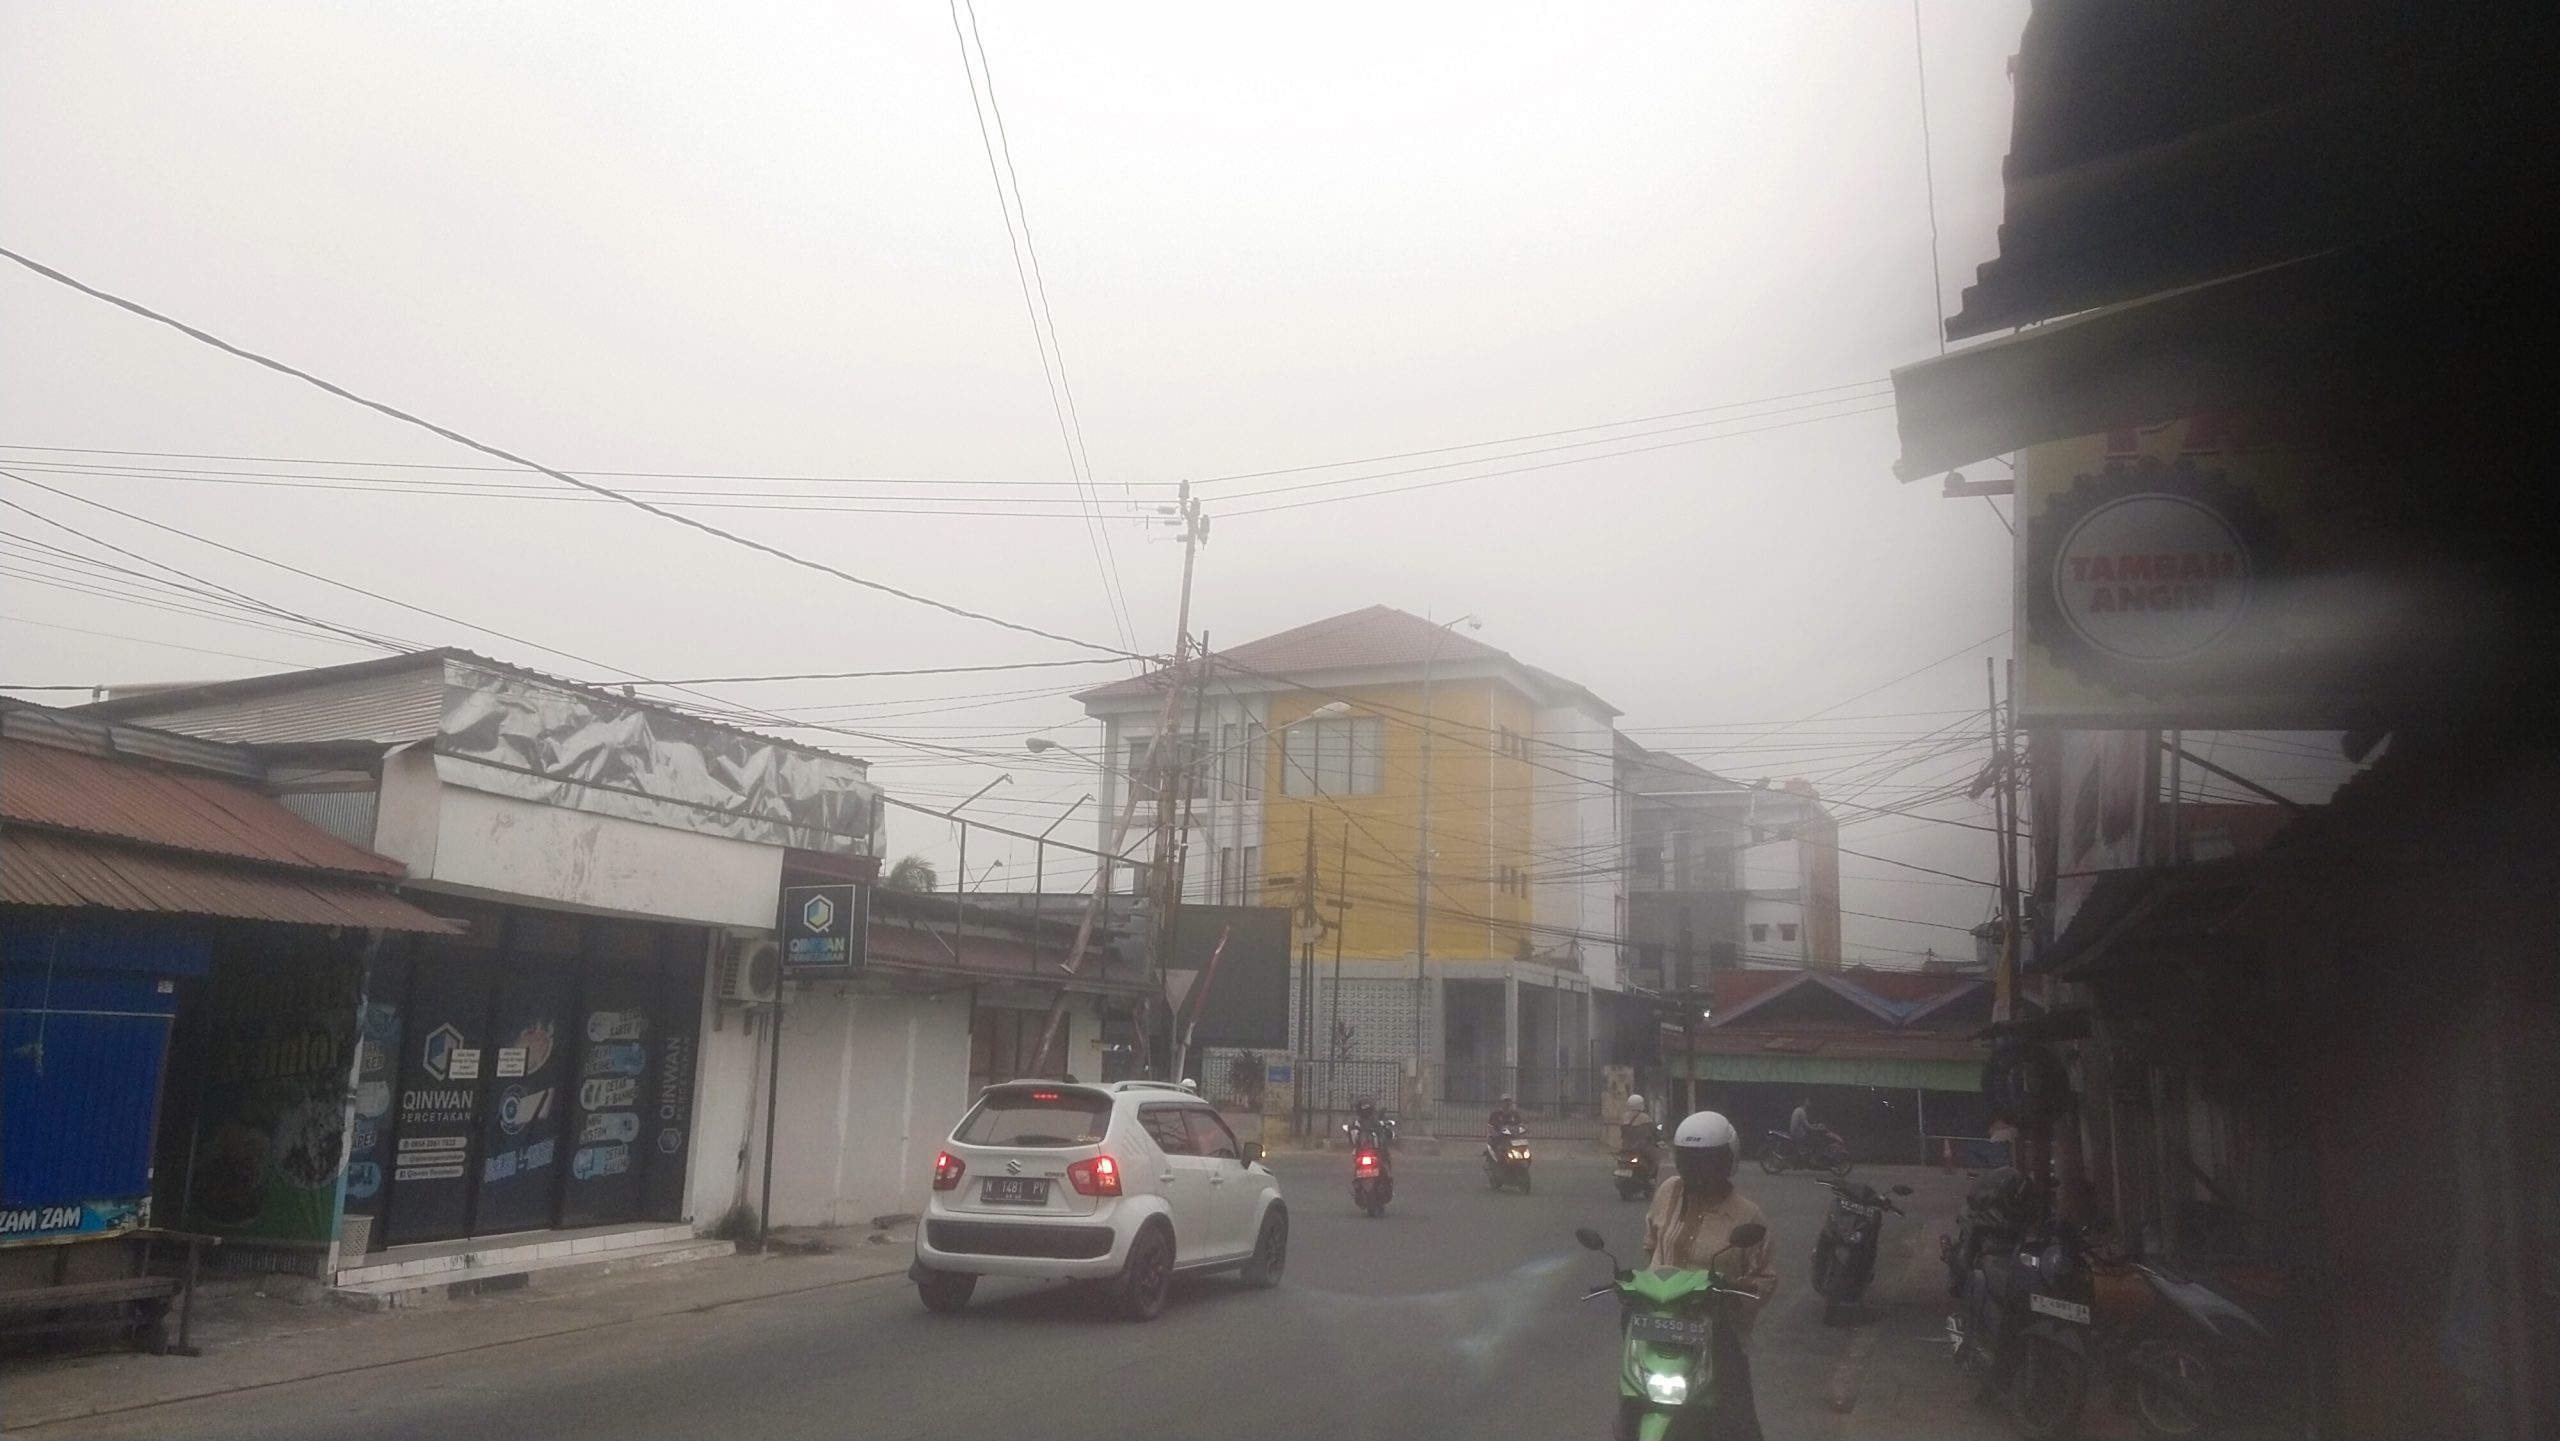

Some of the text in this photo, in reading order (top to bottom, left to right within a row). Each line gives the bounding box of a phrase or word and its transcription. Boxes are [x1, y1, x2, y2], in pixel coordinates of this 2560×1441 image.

[2071, 553, 2235, 583] TAMBAH
[2091, 586, 2214, 613] ANGIN
[660, 1037, 681, 1120] QINWAN
[403, 1090, 473, 1111] QINWAN
[985, 1180, 993, 1193] N
[1033, 1181, 1046, 1195] PV
[0, 1206, 81, 1232] ZAM ZAM
